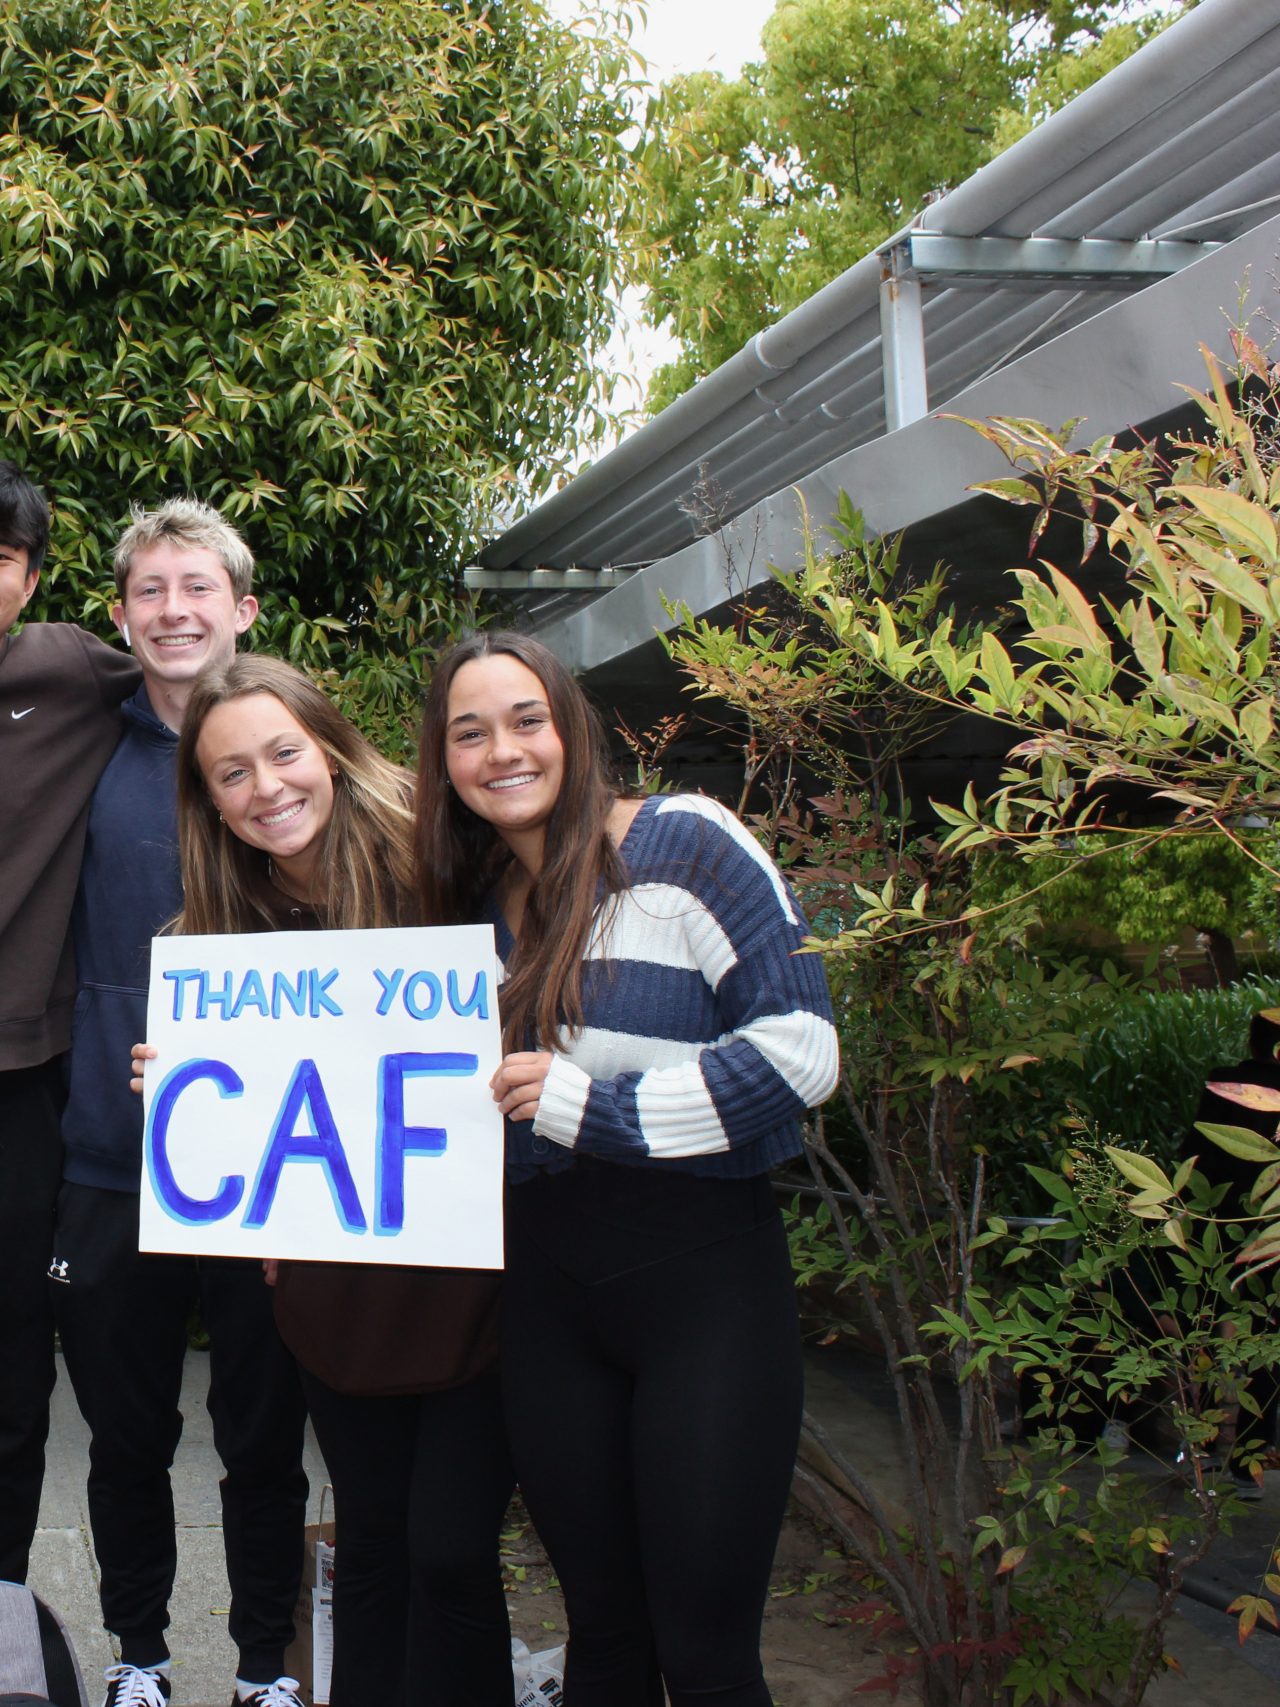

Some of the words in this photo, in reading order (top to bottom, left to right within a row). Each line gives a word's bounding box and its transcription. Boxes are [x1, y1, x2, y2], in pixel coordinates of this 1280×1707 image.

[162, 968, 344, 1022] THANK
[373, 968, 490, 1021] YOU
[145, 1052, 479, 1237] CAF
